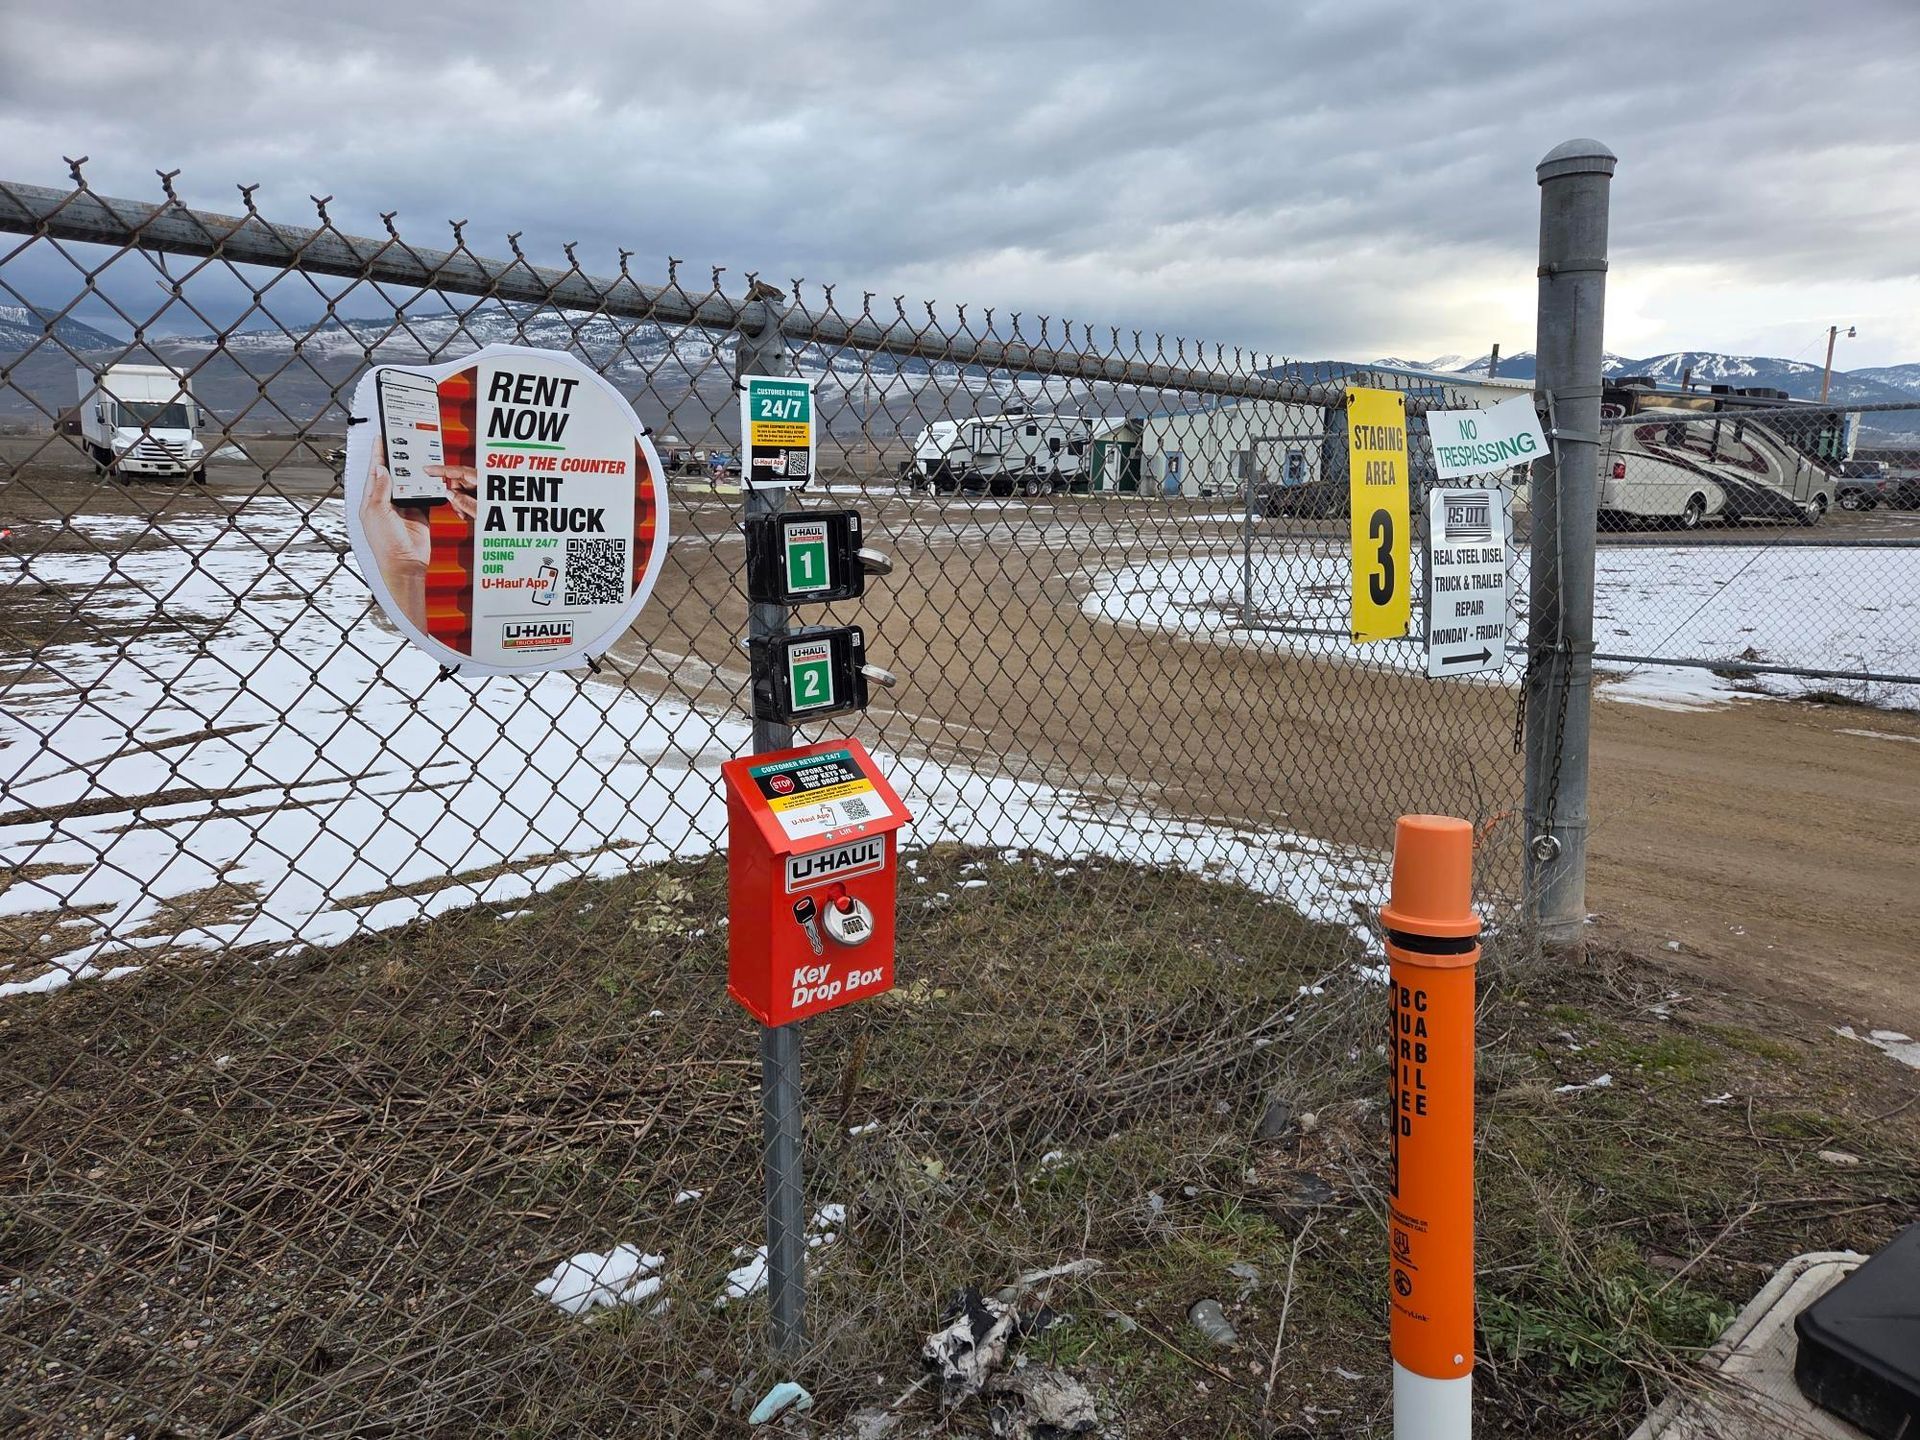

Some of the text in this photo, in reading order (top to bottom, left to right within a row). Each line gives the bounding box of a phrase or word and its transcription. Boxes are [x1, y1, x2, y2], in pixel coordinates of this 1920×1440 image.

[487, 371, 579, 408] RENT
[757, 388, 805, 397] CUSTOMER RETURN
[761, 398, 802, 419] 24/7
[487, 407, 569, 442] NOW
[1459, 419, 1477, 440] NO
[1354, 425, 1403, 451] STAGING
[1437, 432, 1537, 468] TRESPASSING
[486, 453, 626, 474] SKIP THE COUNTER
[1366, 461, 1395, 485] AREA
[487, 475, 563, 502] RENT
[484, 506, 605, 533] A TRUCK
[790, 528, 822, 536] U-HAUL
[483, 538, 558, 548] DIGITALLY 24/7
[482, 551, 514, 561] USING
[800, 551, 812, 579] 1
[1369, 508, 1395, 606] 3
[1434, 548, 1504, 565] REAL STEEL DISEL
[482, 564, 504, 574] OUR
[526, 578, 549, 590] App
[1435, 573, 1503, 592] TRUCK & TRAILER
[1455, 600, 1484, 617] REPAIR
[506, 623, 571, 638] U-HAUL
[1432, 627, 1468, 646] MONDAY
[1475, 623, 1504, 641] FRIDAY
[794, 646, 826, 657] U-HAUL
[803, 670, 820, 698] 2
[761, 753, 841, 774] CUSTOMER RETURN 24/7
[796, 763, 839, 777] BEFORE YOU
[772, 780, 791, 789] STOP
[800, 774, 819, 783] DROP
[819, 770, 839, 779] KEYS
[803, 773, 856, 789] THIS DROP BOX
[839, 828, 853, 836] Lift
[792, 843, 879, 879] U-HAUL
[792, 963, 831, 988] Key
[791, 966, 884, 1008] Drop Box
[1400, 987, 1412, 1137] BURIED
[1414, 990, 1428, 1116] CABLE
